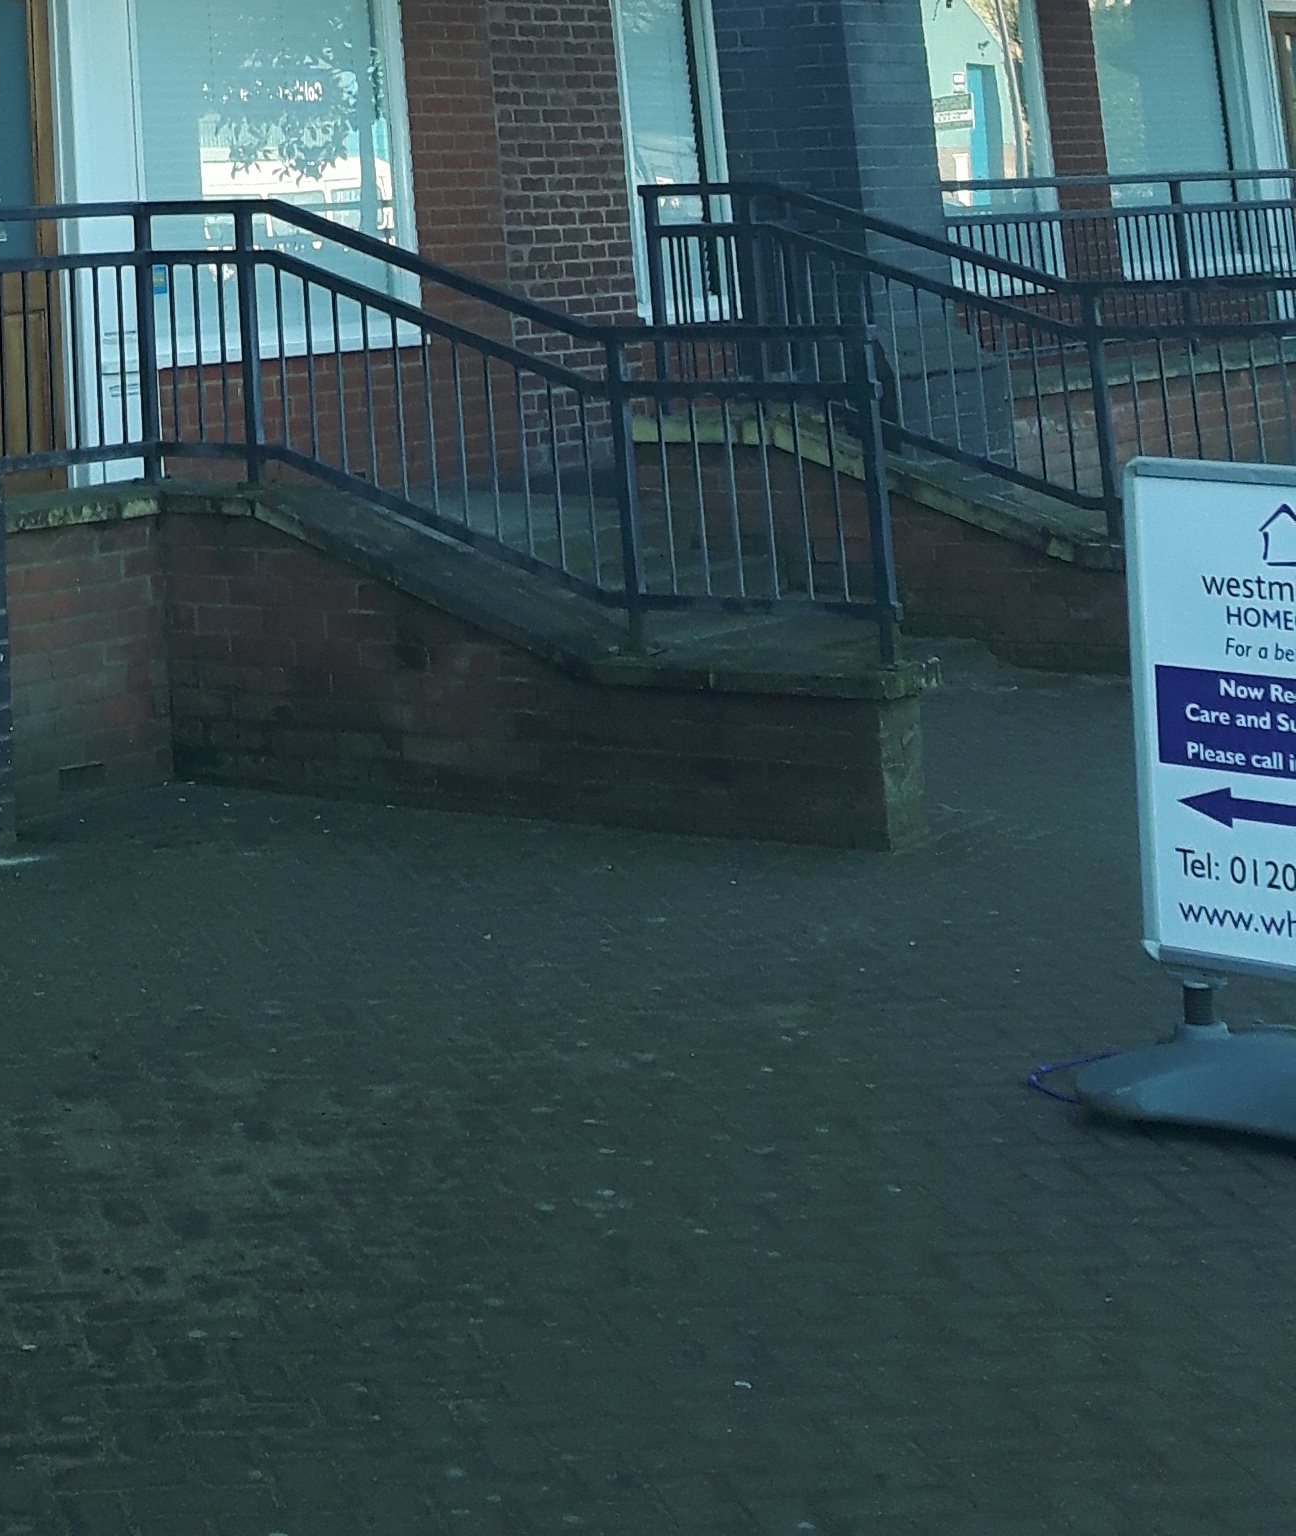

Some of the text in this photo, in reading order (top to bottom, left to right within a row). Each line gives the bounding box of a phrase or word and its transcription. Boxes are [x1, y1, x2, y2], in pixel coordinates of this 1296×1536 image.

[1201, 575, 1294, 603] westm
[1226, 605, 1296, 631] HOME
[1225, 637, 1253, 658] For
[1258, 646, 1268, 659] a
[1219, 678, 1265, 701] Now
[1185, 703, 1231, 725] Care
[1235, 711, 1272, 730] and
[1186, 741, 1247, 766] Please
[1251, 751, 1284, 770] call
[1175, 847, 1220, 881] Tel:
